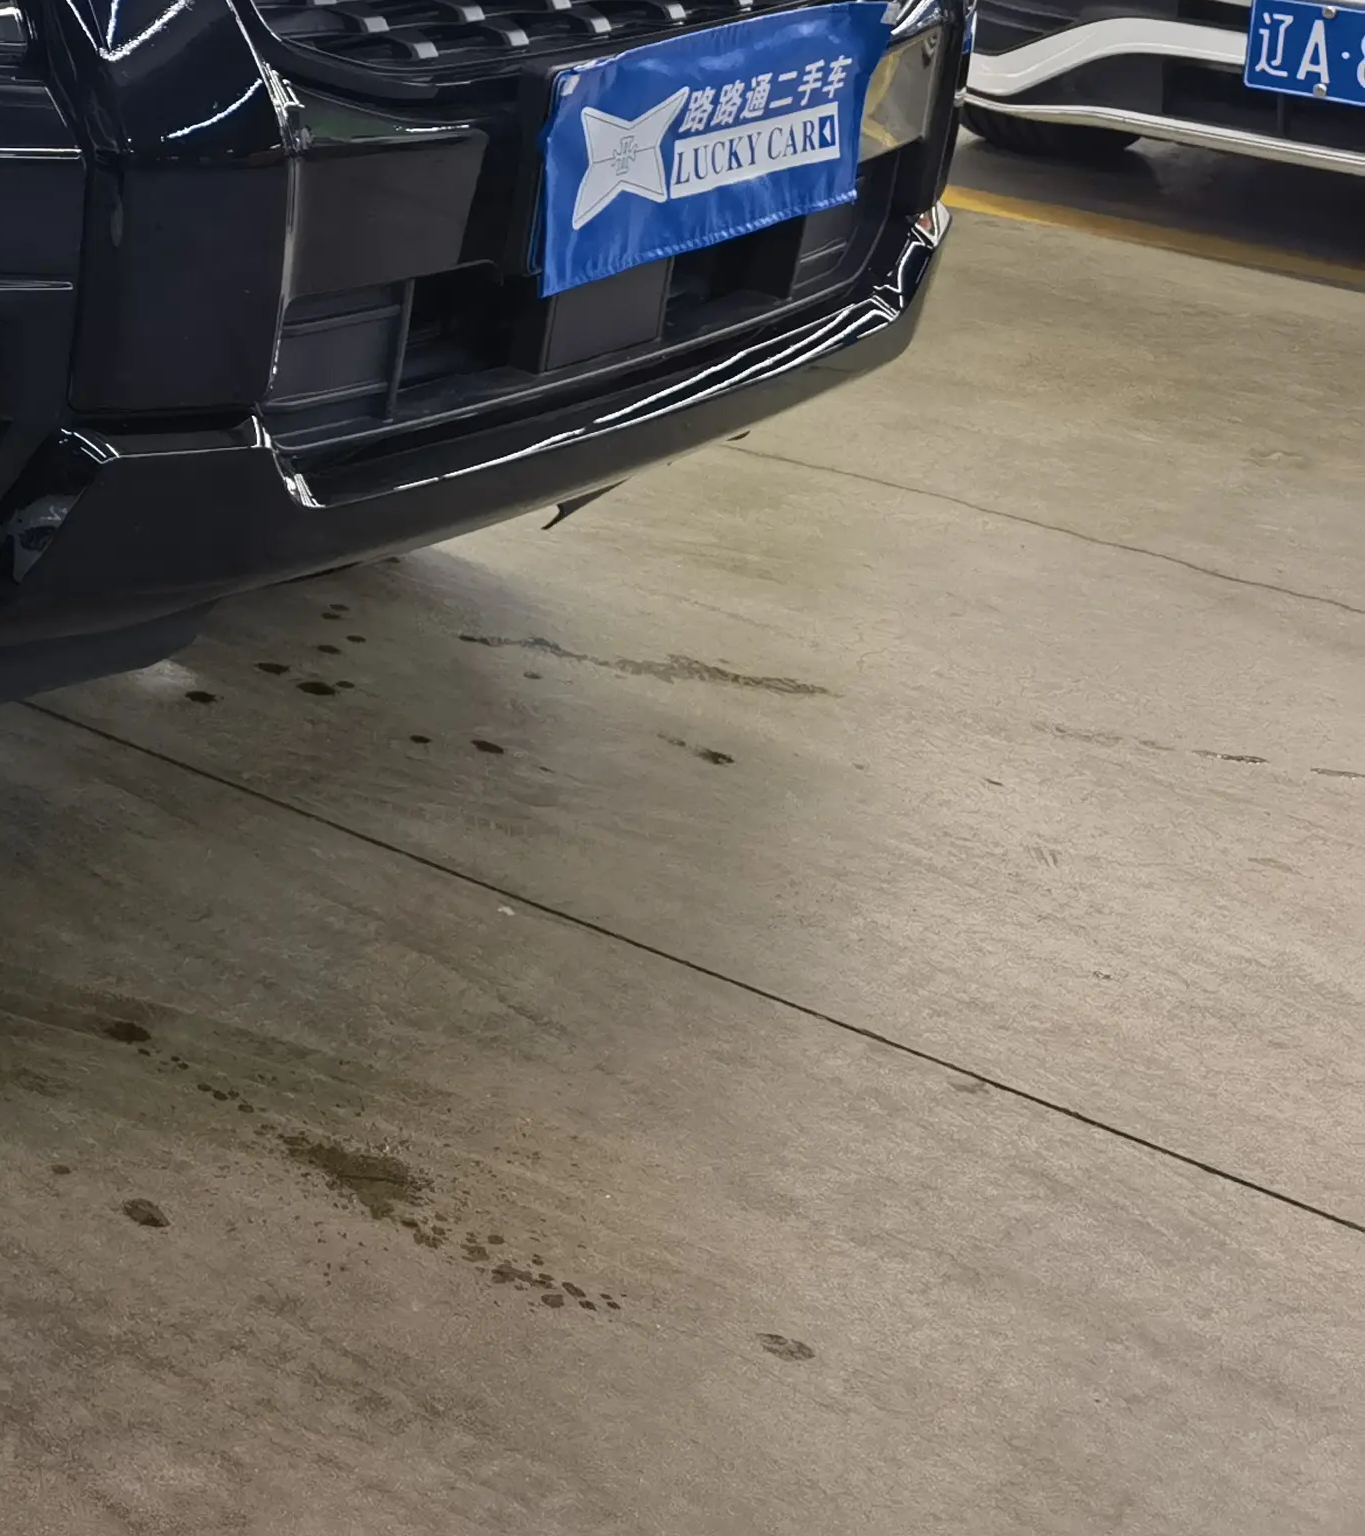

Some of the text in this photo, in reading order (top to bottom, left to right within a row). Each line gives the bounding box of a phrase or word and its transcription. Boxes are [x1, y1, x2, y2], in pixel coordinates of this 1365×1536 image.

[678, 54, 852, 134] 路路通二手车
[673, 119, 816, 185] LUCKY CAR
